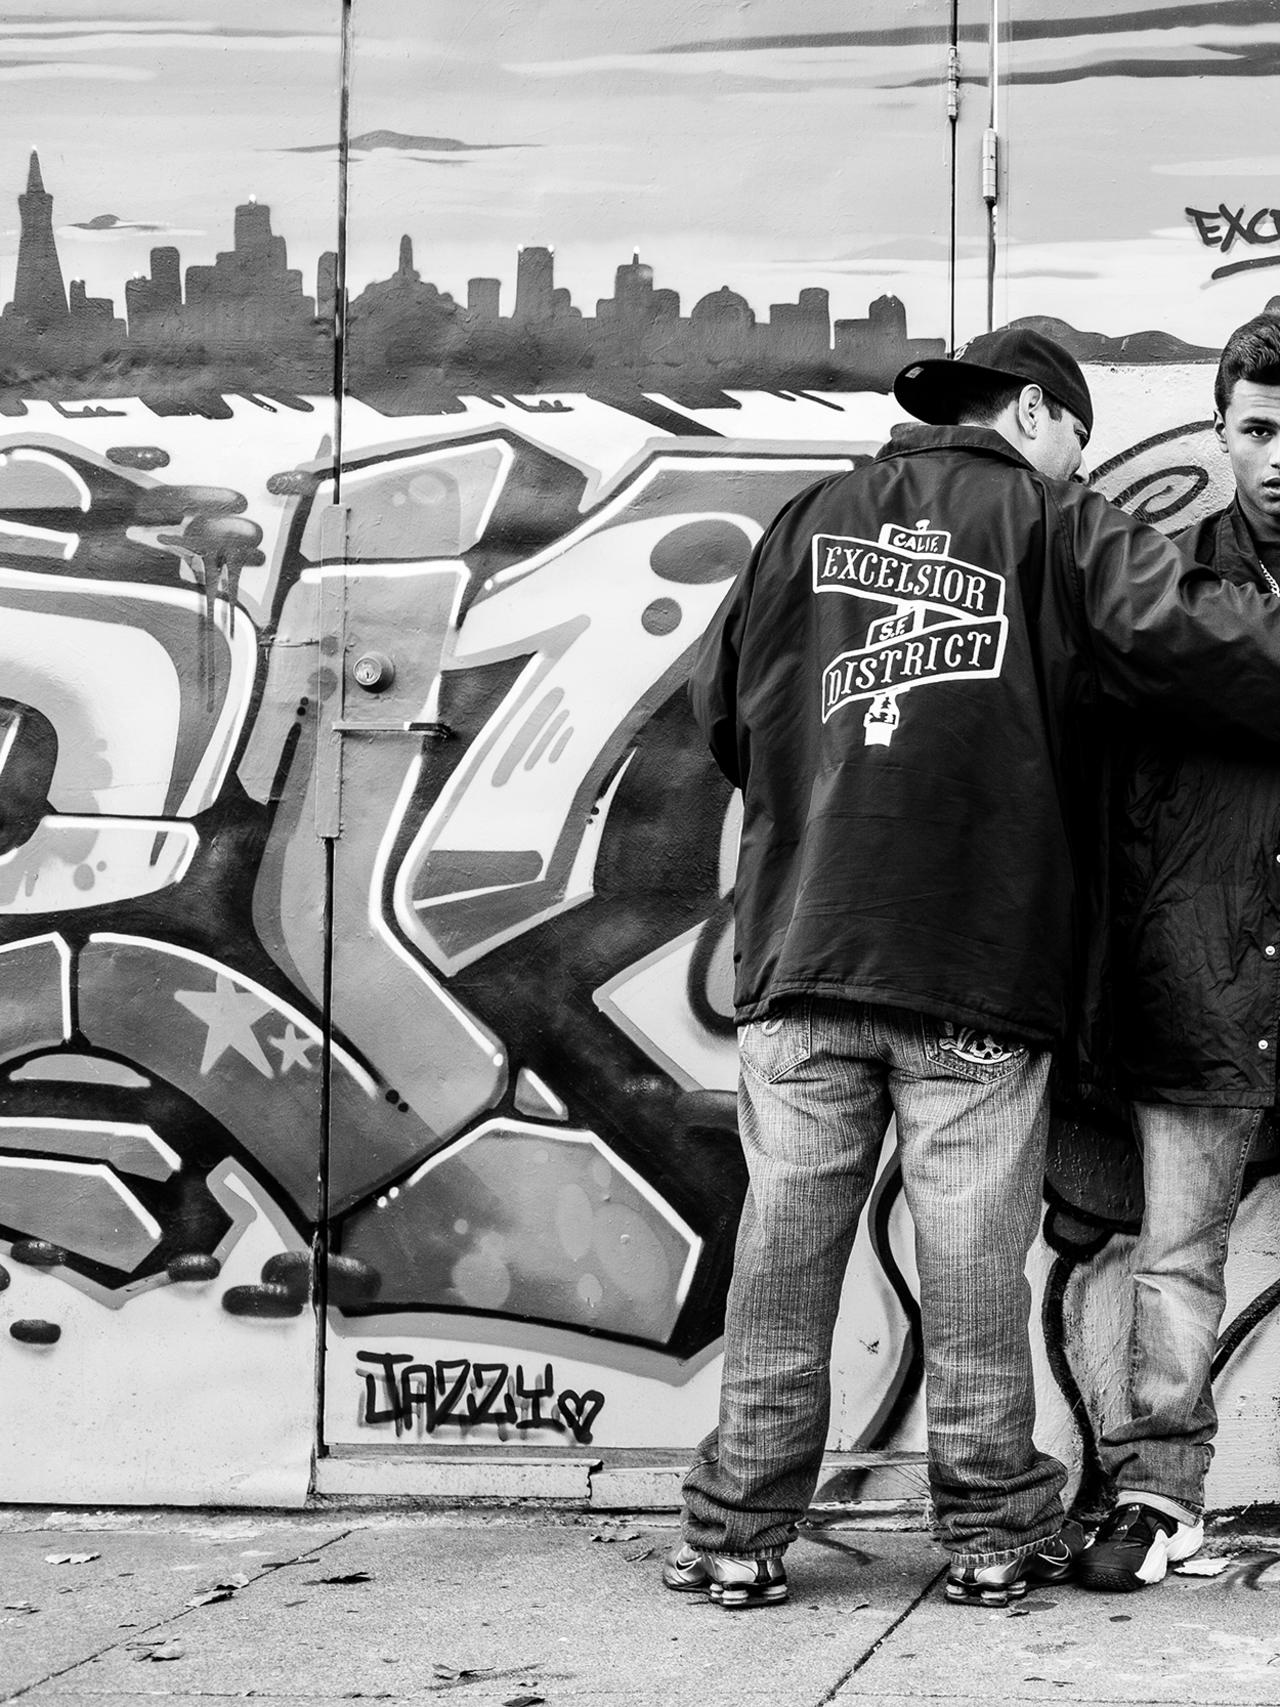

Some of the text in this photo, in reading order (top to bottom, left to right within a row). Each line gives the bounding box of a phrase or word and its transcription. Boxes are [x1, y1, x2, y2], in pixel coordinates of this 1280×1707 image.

[892, 532, 940, 553] CALIF.
[821, 546, 987, 611] EXCELSIOR
[826, 631, 992, 707] DISTRICT
[356, 1350, 566, 1442] JAZZY
